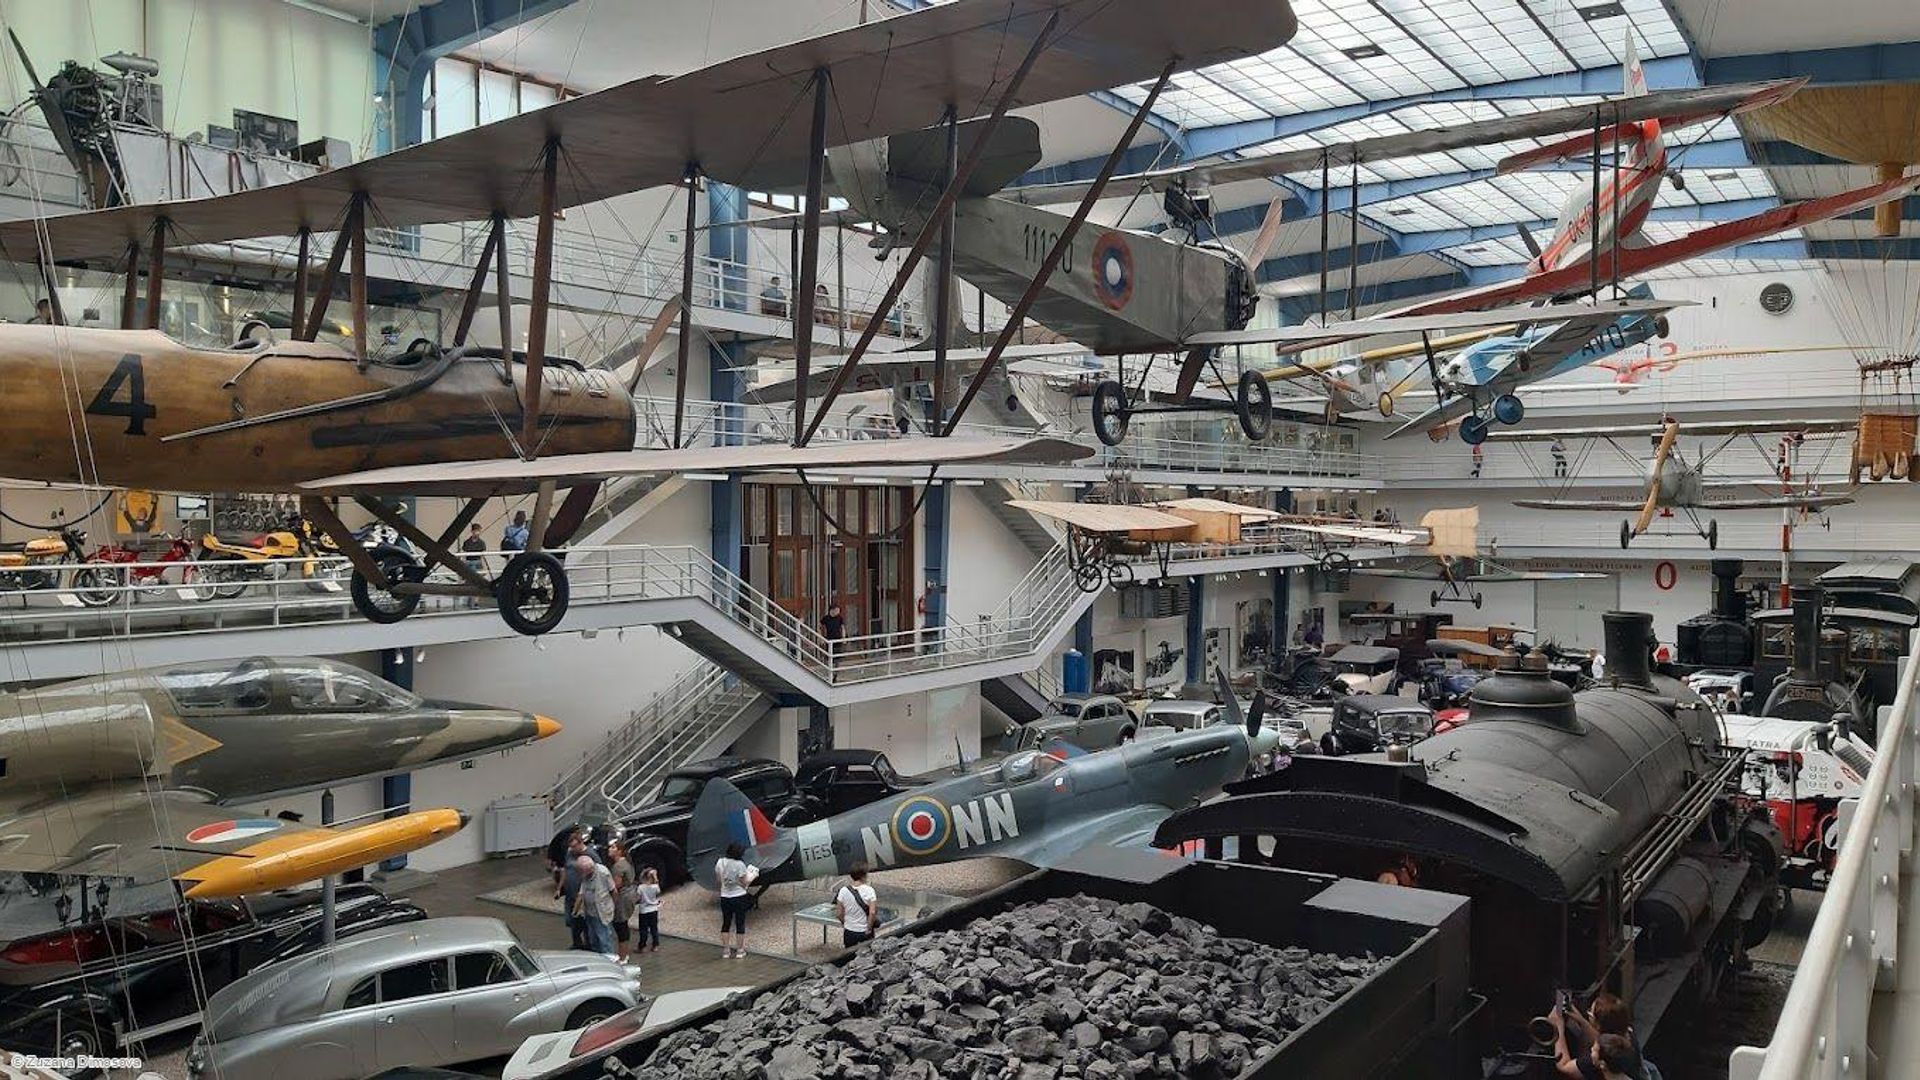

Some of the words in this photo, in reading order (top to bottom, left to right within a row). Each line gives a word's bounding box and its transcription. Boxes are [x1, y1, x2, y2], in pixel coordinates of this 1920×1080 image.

[85, 353, 157, 436] 4
[1746, 739, 1781, 750] TATRA
[861, 822, 896, 868] N
[951, 791, 1020, 850] NN
